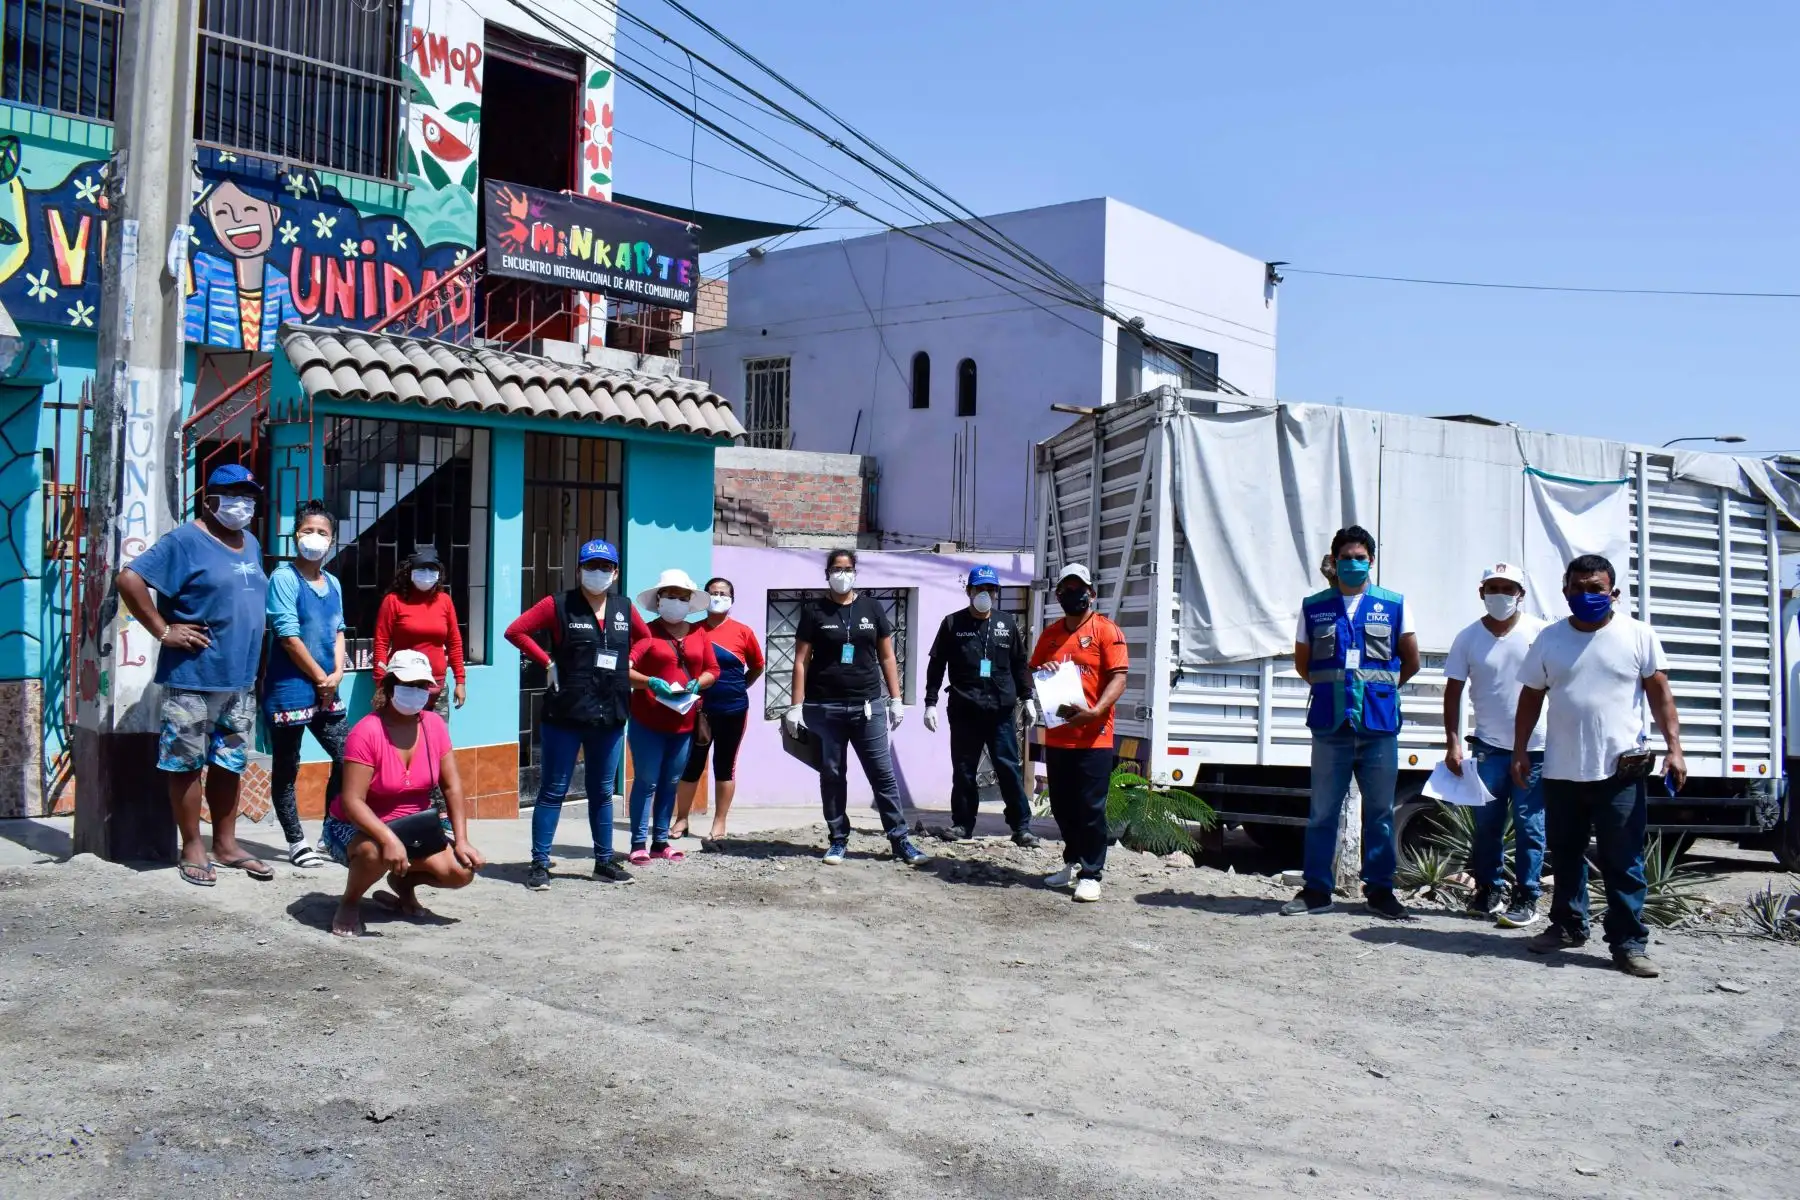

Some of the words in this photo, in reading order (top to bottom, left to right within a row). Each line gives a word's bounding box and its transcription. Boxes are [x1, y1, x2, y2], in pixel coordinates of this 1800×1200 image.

[405, 25, 482, 94] AMOR
[502, 255, 552, 276] ENCUENTRO
[553, 265, 611, 288] INTERNACIONAL
[613, 276, 624, 290] DE
[625, 278, 643, 294] ARTE
[644, 285, 690, 303] COMUNITARIO
[568, 622, 593, 630] CULTURA
[1366, 614, 1389, 622] LIMA
